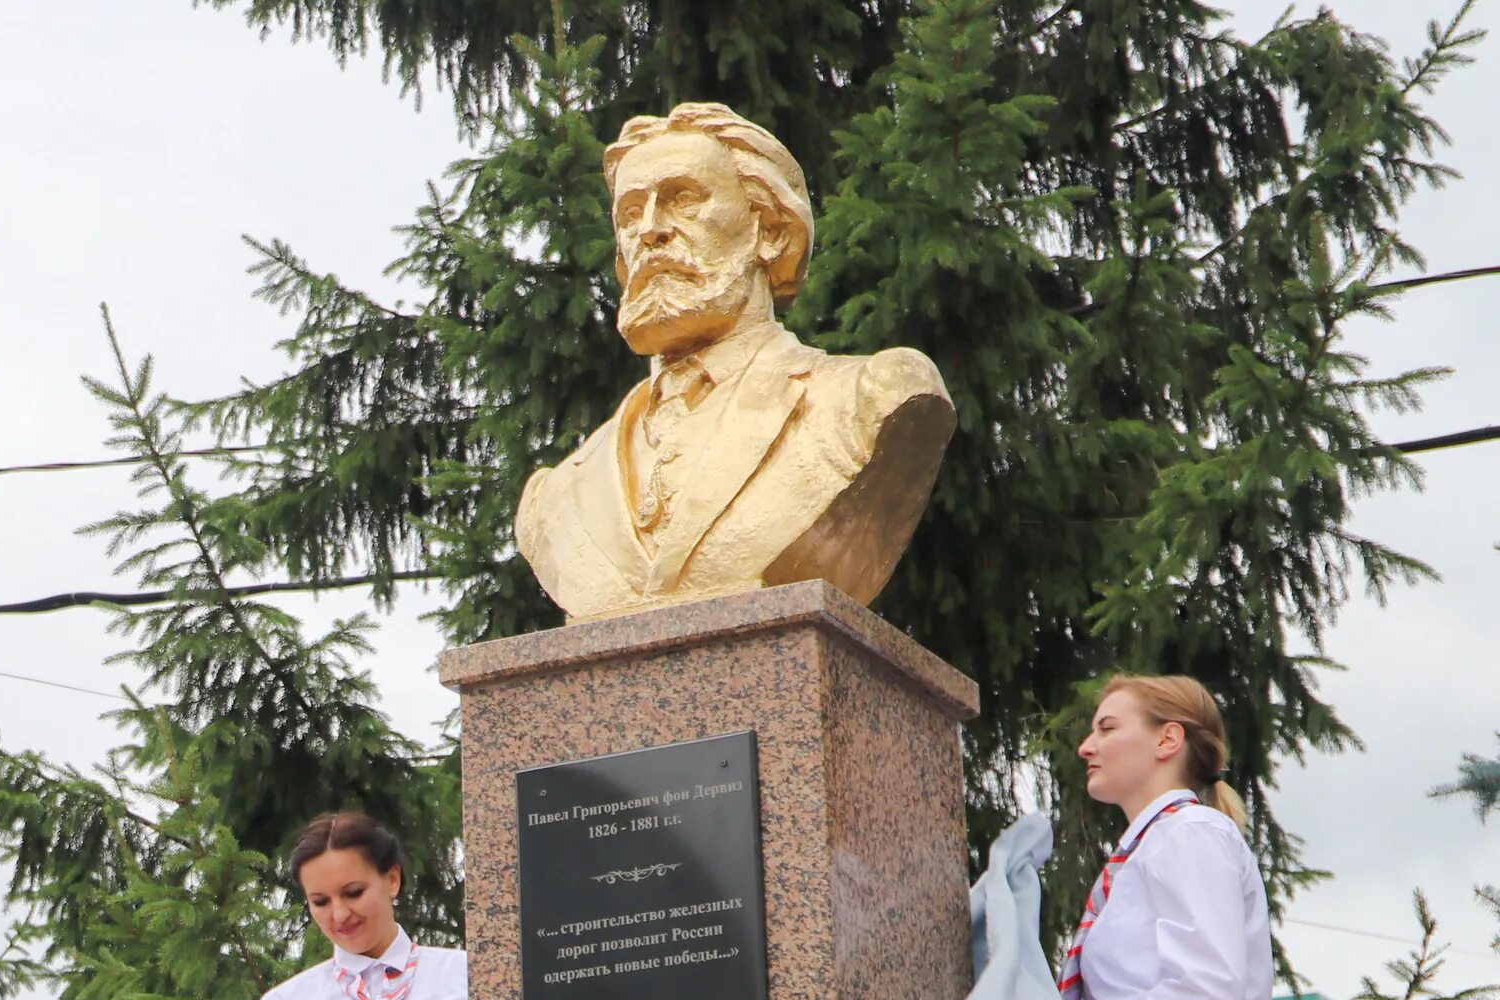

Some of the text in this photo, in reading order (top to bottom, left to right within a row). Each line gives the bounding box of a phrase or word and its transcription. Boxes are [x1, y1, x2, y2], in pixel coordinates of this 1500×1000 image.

[528, 780, 744, 826] Павел Григорьевич фон Дервиз
[588, 823, 618, 840] 1826
[630, 816, 658, 832] 1881
[664, 815, 682, 827] г.г.
[560, 910, 666, 937] строительство
[669, 897, 743, 918] железных
[556, 924, 724, 960] дорог позволит России
[543, 947, 740, 984] одержать новые победы...»
